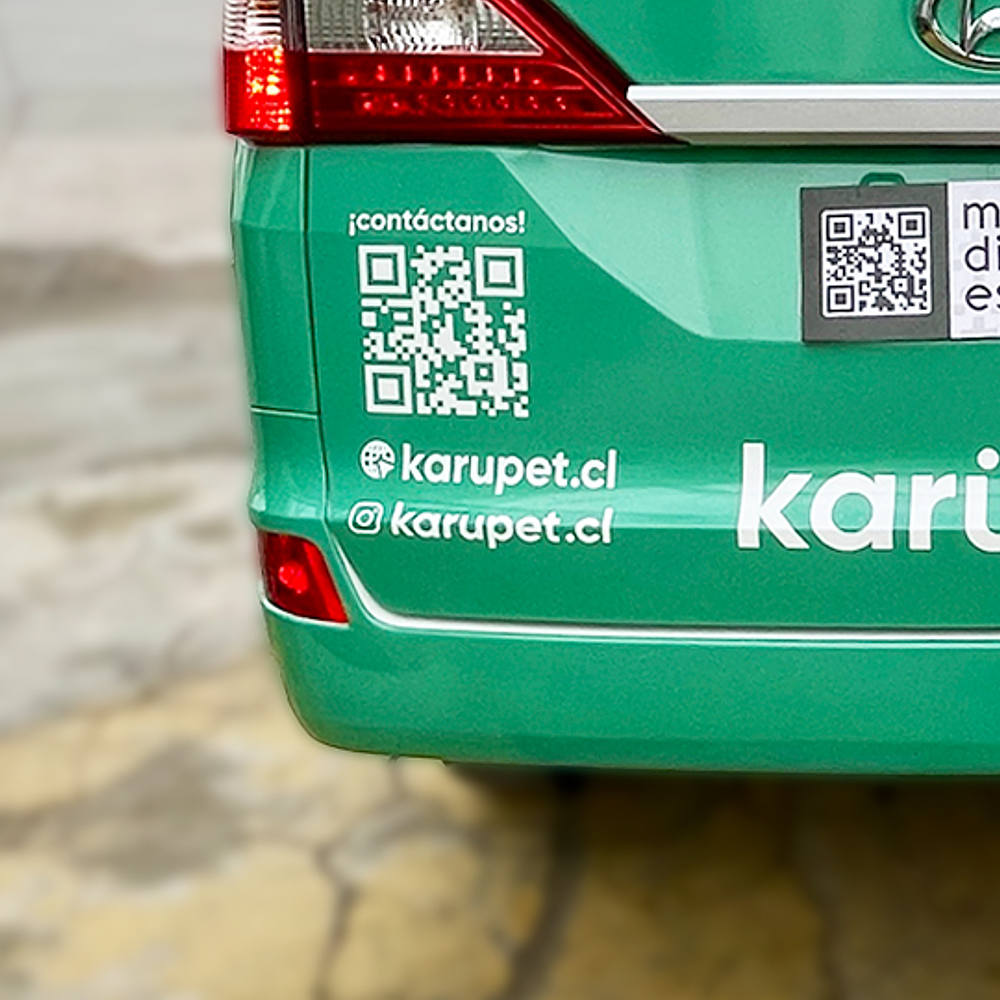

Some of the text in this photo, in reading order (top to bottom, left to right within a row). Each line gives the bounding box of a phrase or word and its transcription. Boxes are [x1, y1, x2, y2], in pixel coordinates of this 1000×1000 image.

[348, 208, 526, 237] ¡contáctanos!
[401, 442, 618, 495] karupet.cl
[390, 501, 615, 550] karupet.cl
